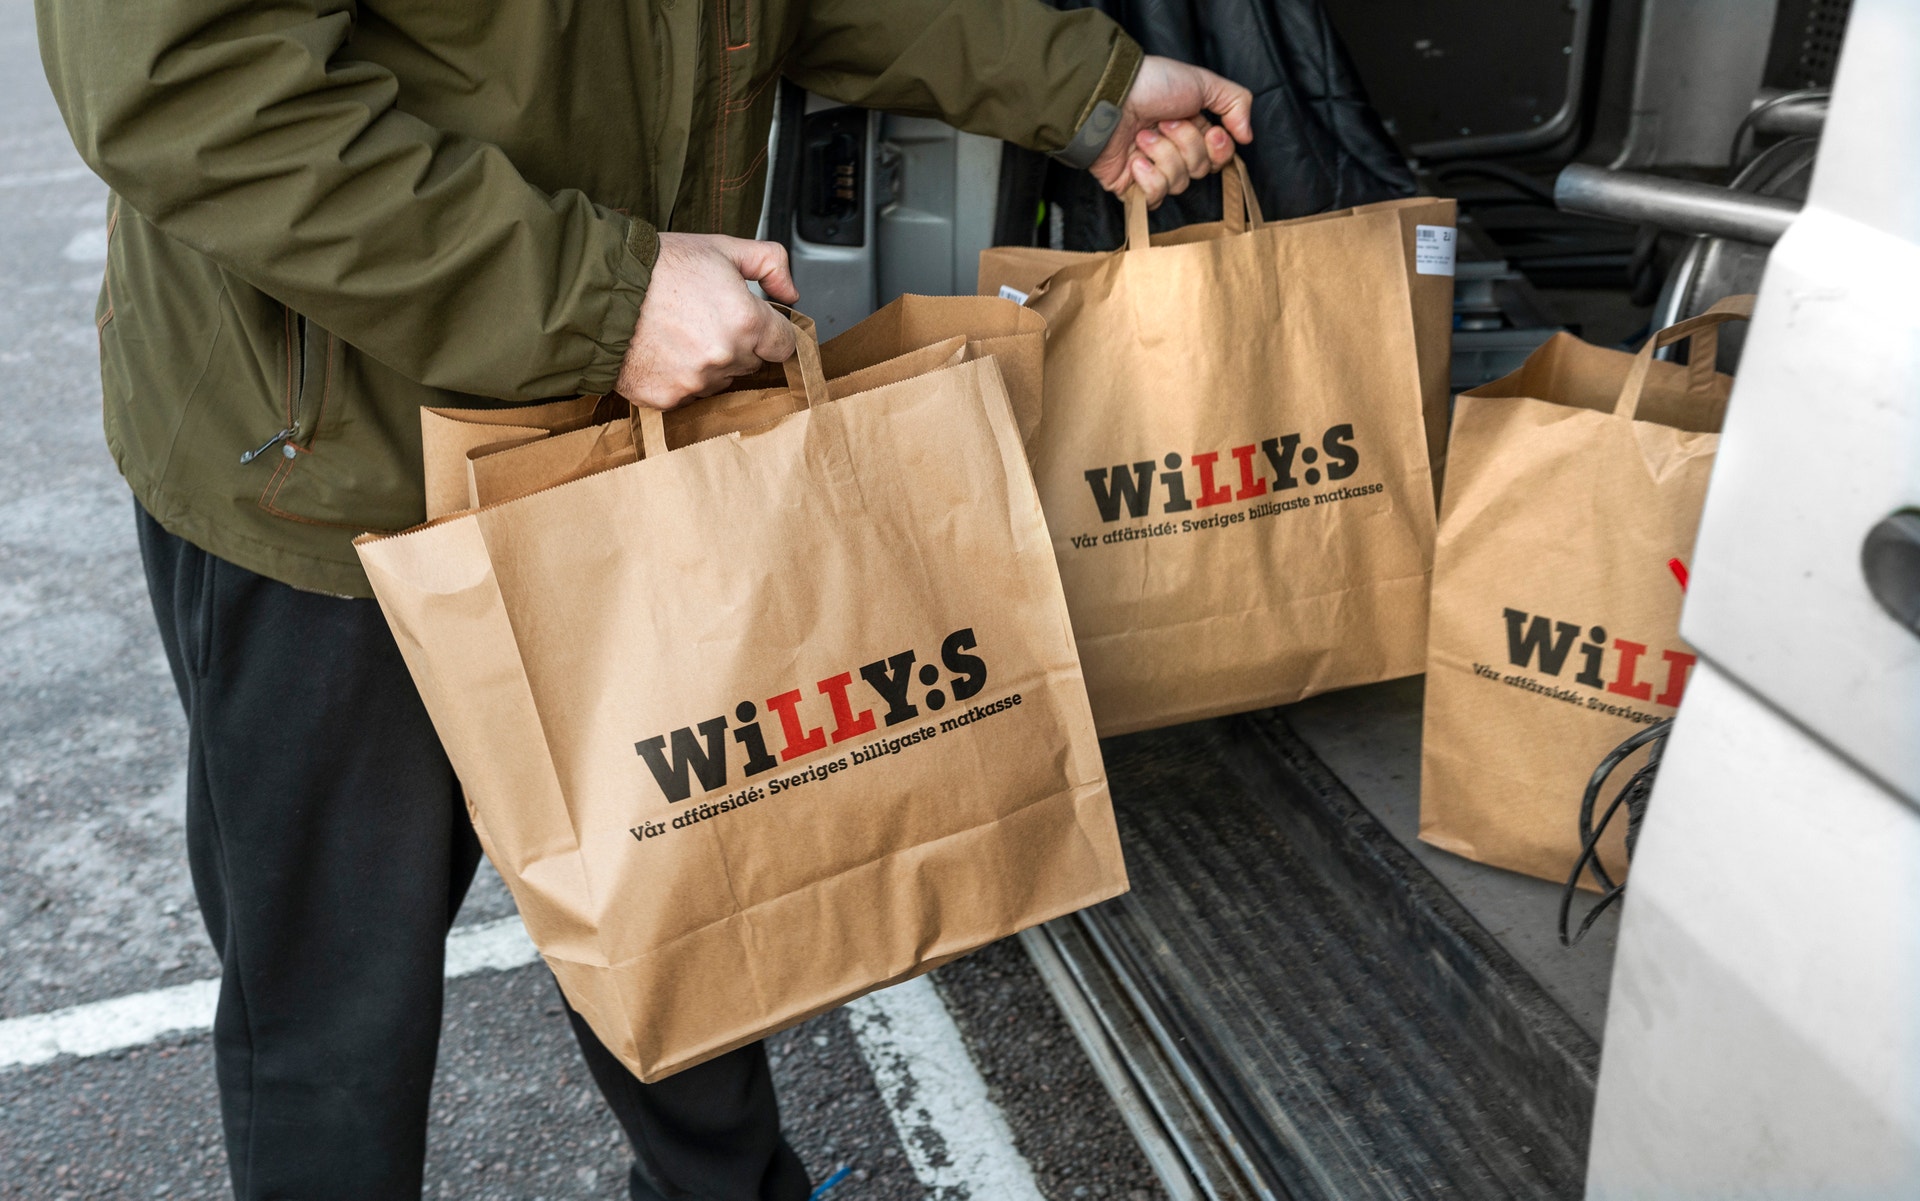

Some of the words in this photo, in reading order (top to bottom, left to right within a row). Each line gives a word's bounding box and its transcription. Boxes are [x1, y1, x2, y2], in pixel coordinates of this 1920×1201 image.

[1071, 532, 1098, 549] Vår
[1102, 522, 1178, 546] affärsidé:
[1182, 507, 1245, 533] Sveriges
[1249, 497, 1311, 521] billigaste
[1314, 483, 1384, 506] matkasse
[1084, 424, 1360, 523] WiLLY:S
[630, 819, 666, 842] Vår
[671, 786, 767, 831] affärsidé:
[768, 756, 848, 795] Sveriges
[850, 724, 936, 766] billigaste
[939, 692, 1023, 734] matkasse
[634, 627, 988, 804] WiLLY:S
